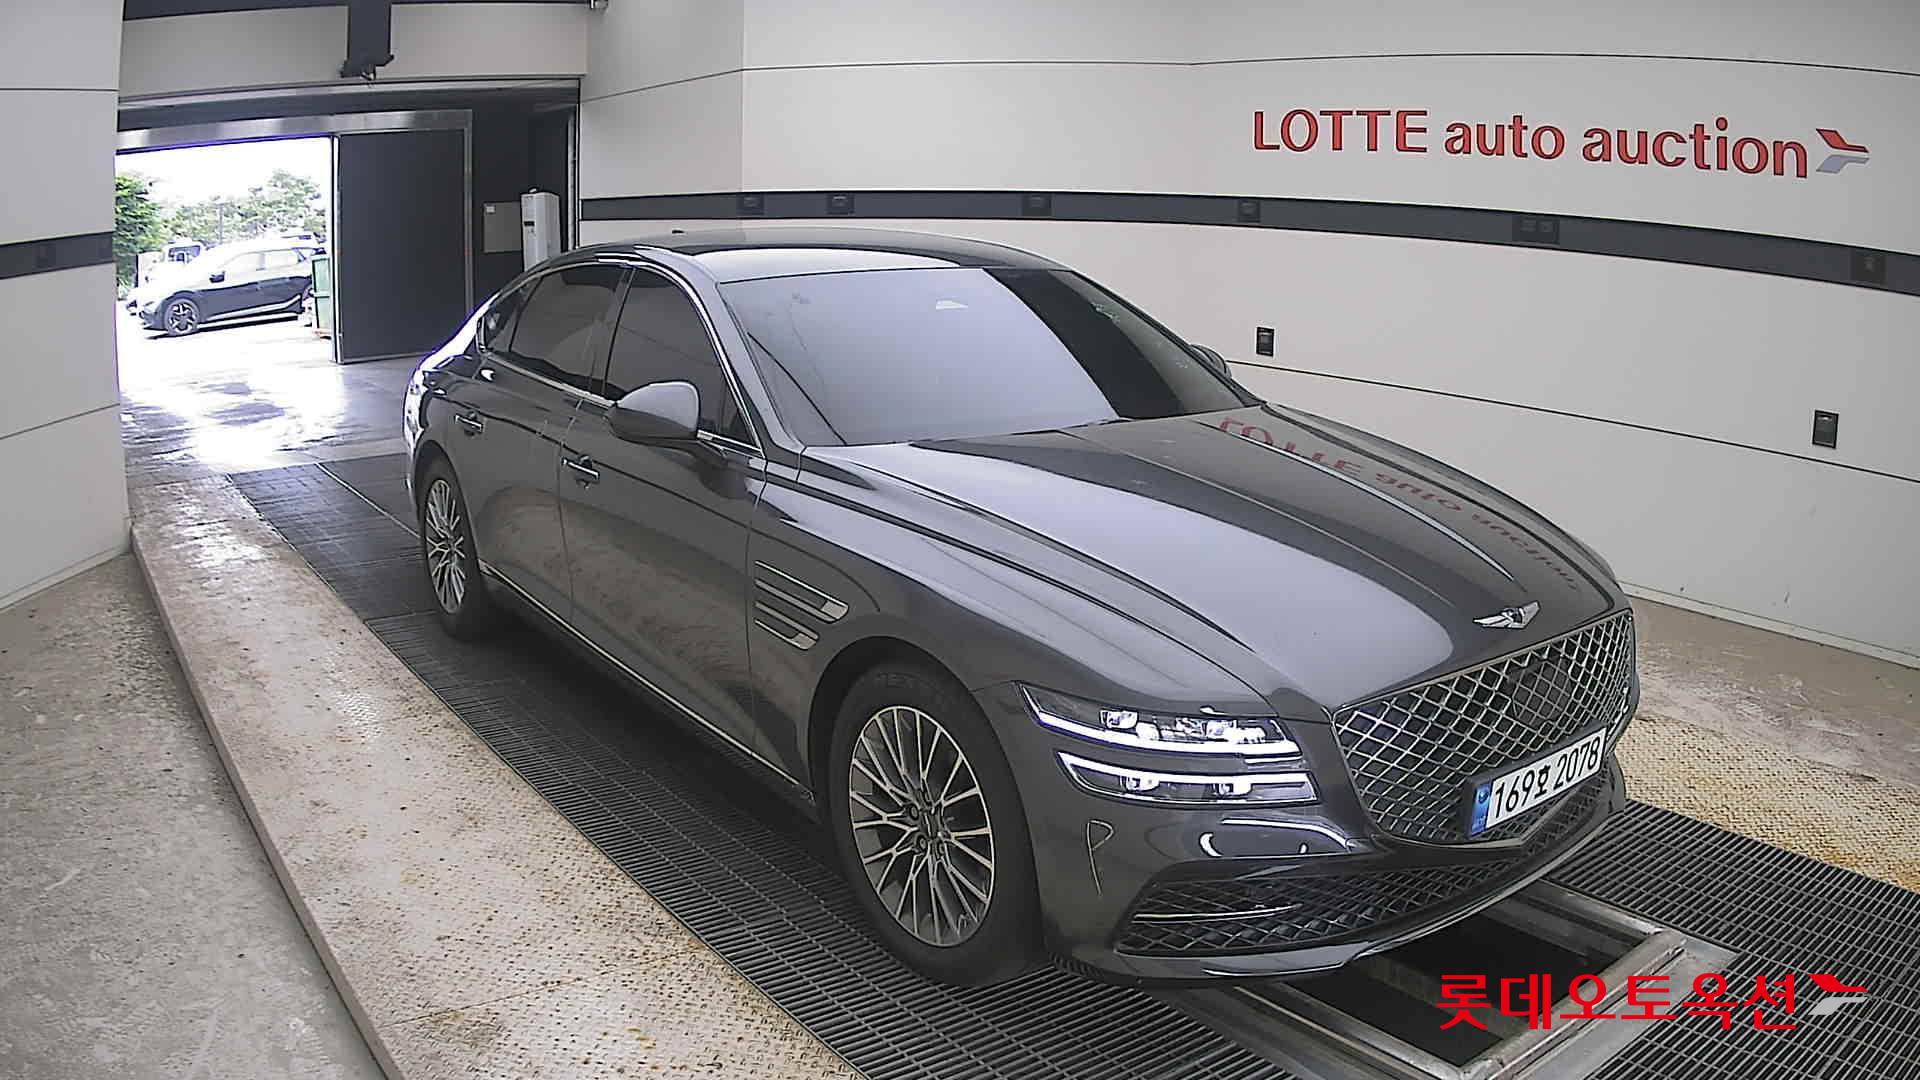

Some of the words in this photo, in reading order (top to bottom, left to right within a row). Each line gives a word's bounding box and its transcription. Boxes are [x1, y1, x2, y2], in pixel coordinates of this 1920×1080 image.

[1253, 109, 1428, 153] LOTTE
[1444, 115, 1566, 160] auto
[1582, 116, 1808, 178] auction
[1495, 764, 1552, 819] 169호
[1553, 736, 1601, 791] 2078
